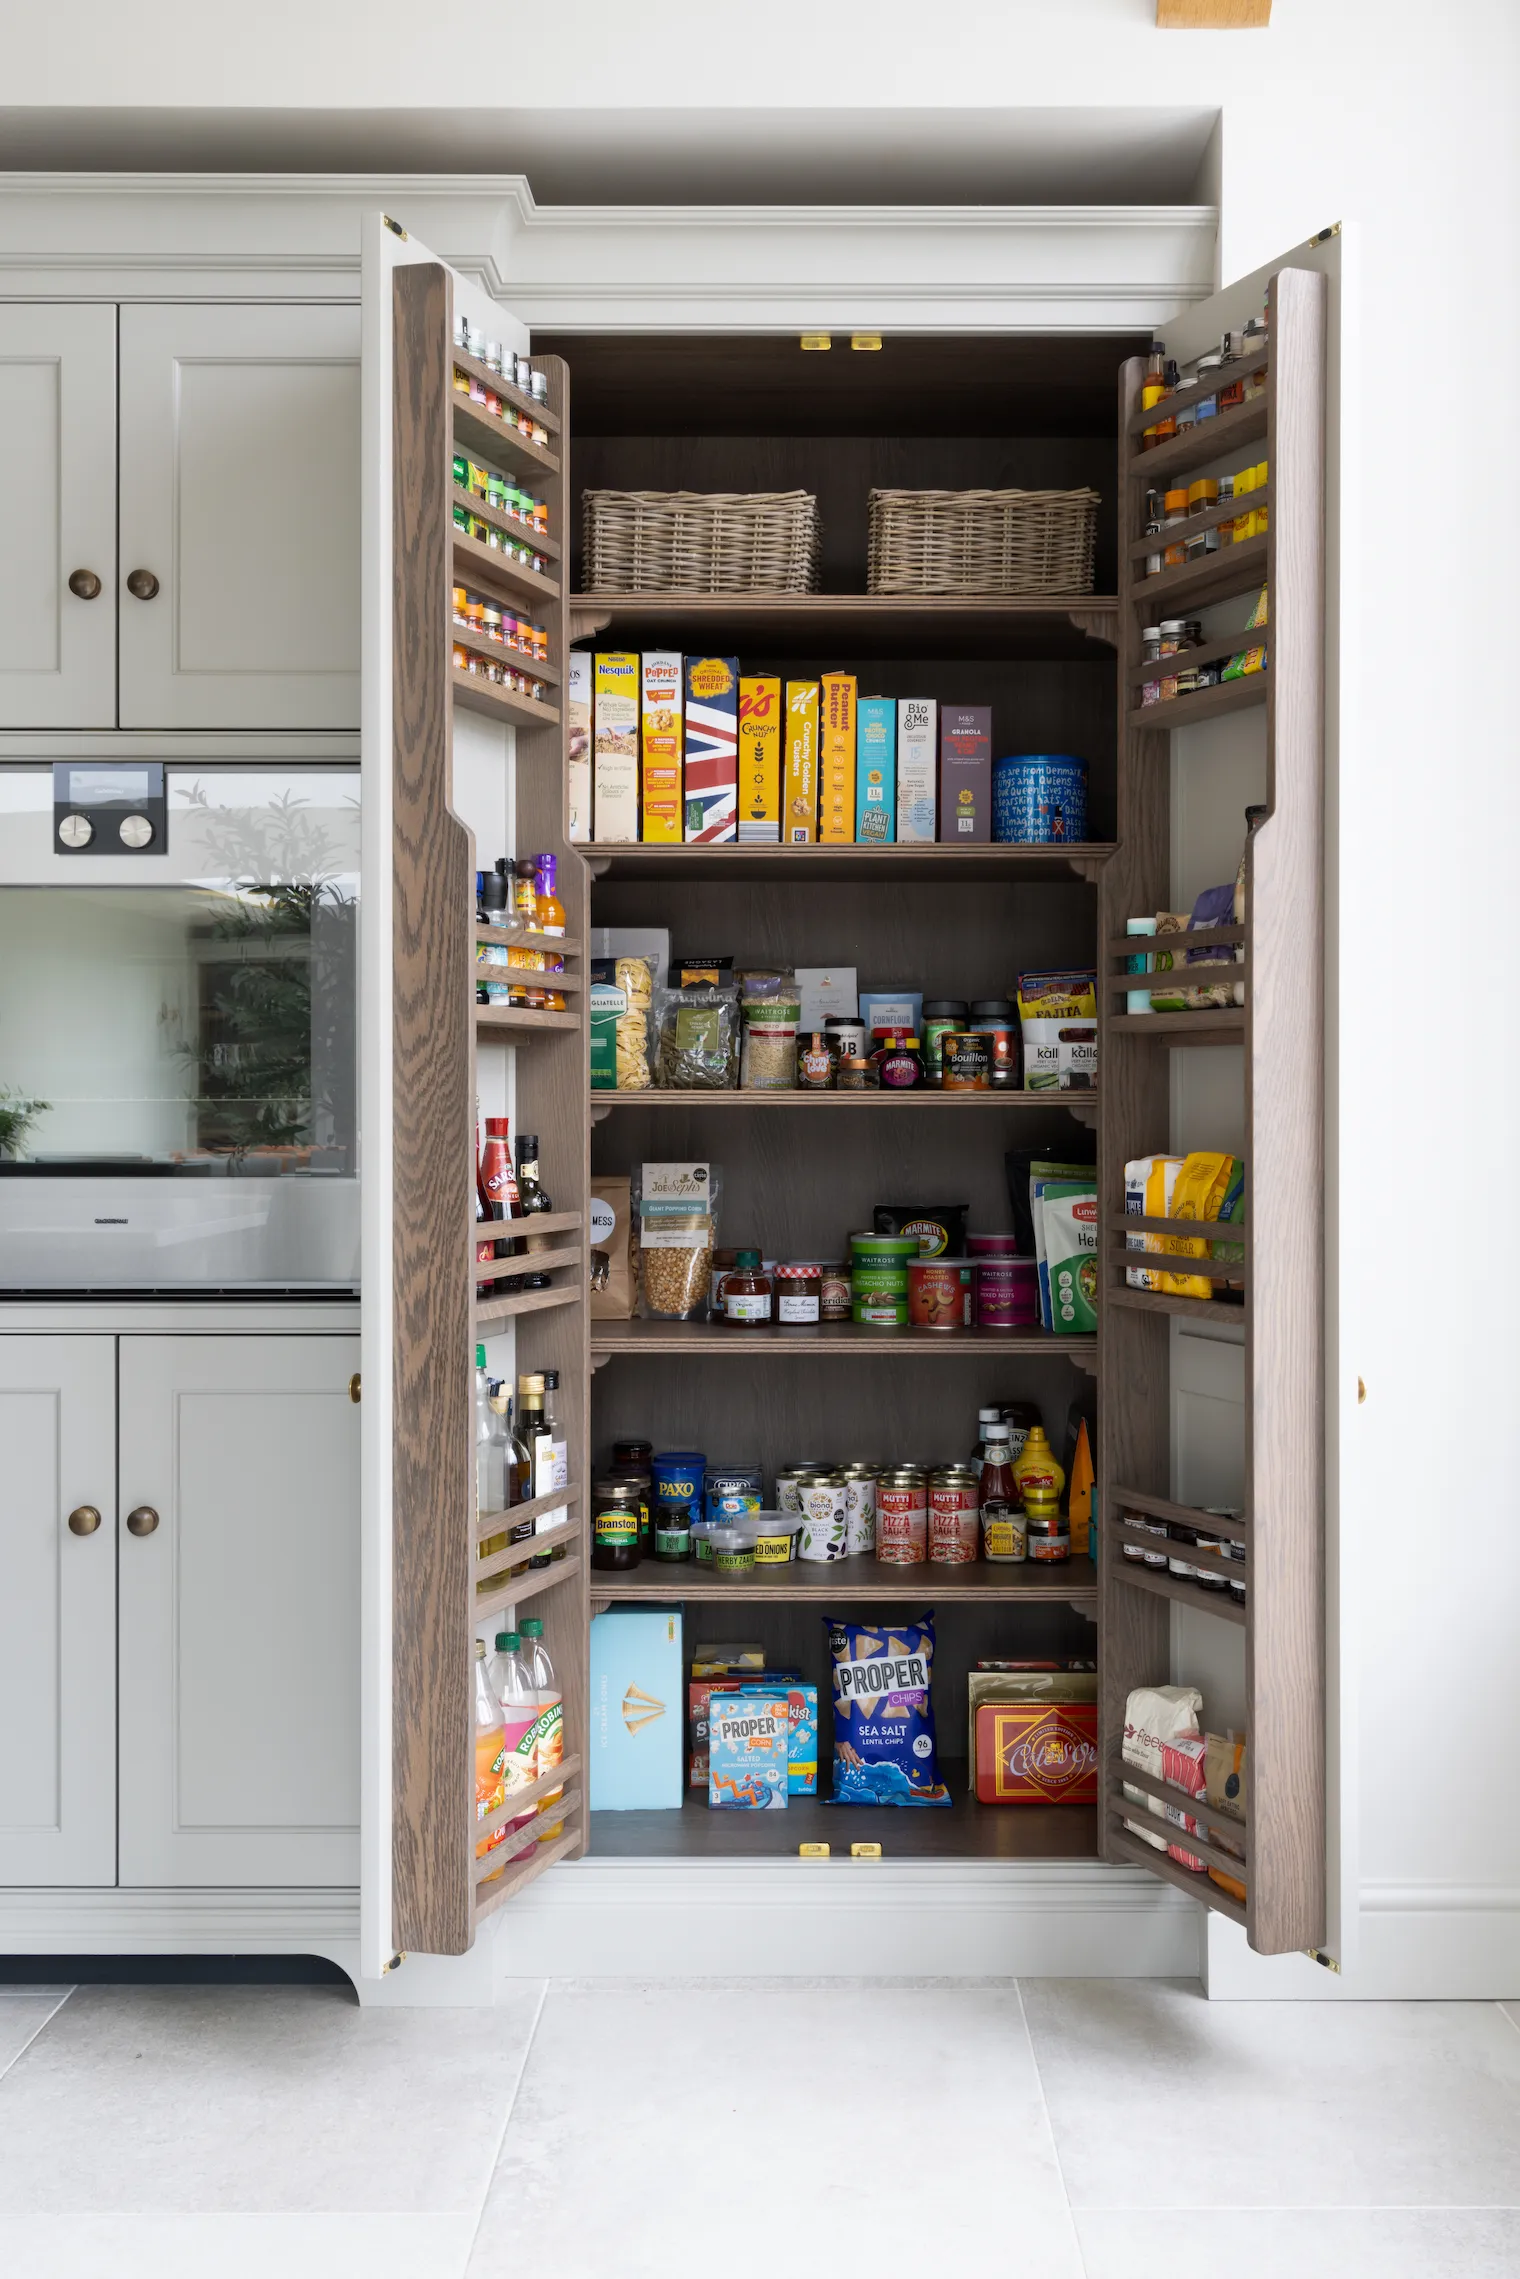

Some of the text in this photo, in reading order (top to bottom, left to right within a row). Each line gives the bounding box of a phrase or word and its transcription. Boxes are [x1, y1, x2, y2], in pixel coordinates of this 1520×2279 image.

[599, 664, 634, 676] Nesquik
[692, 675, 730, 683] SHREDDED
[830, 683, 840, 729] Butter
[841, 684, 851, 731] Peanut
[908, 703, 928, 714] Bio
[742, 722, 777, 735] CRUNCHY
[793, 739, 802, 777] Clusters
[801, 721, 812, 795] Crunchy Golden
[1007, 768, 1020, 776] are
[1022, 766, 1044, 777] from
[1017, 776, 1035, 785] and
[1010, 786, 1039, 797] Queen
[864, 812, 887, 825] PLANT
[863, 822, 885, 833] KITCHEN
[1005, 827, 1051, 837] afternoon
[862, 829, 884, 838] VEGAN
[755, 1008, 791, 1016] WAITROSE
[1035, 1005, 1081, 1019] FAJITA
[872, 1015, 911, 1025] CORNFLOUR
[951, 1053, 988, 1063] Bouillon
[1037, 1048, 1058, 1059] kall
[885, 1059, 915, 1072] MARMITE
[592, 1215, 613, 1226] MESS
[905, 1222, 941, 1235] MARMITE
[1169, 1240, 1194, 1254] SUGAR
[918, 1281, 956, 1294] CASHEWS
[659, 1482, 694, 1497] PAXO
[883, 1494, 909, 1503] MUTTI
[933, 1493, 959, 1503] MUTTI
[597, 1519, 636, 1530] Branston
[882, 1513, 910, 1526] PIZZA
[933, 1513, 960, 1526] PIZZA
[883, 1527, 910, 1536] SAUCE
[933, 1527, 960, 1536] SAUCE
[755, 1543, 788, 1555] ED ONIONS
[839, 1658, 925, 1696] PROPER
[891, 1691, 923, 1705] CHIPS
[722, 1717, 776, 1740] PROPER
[859, 1725, 907, 1737] SEA SALT
[751, 1738, 771, 1747] CORN
[917, 1739, 928, 1749] 96
